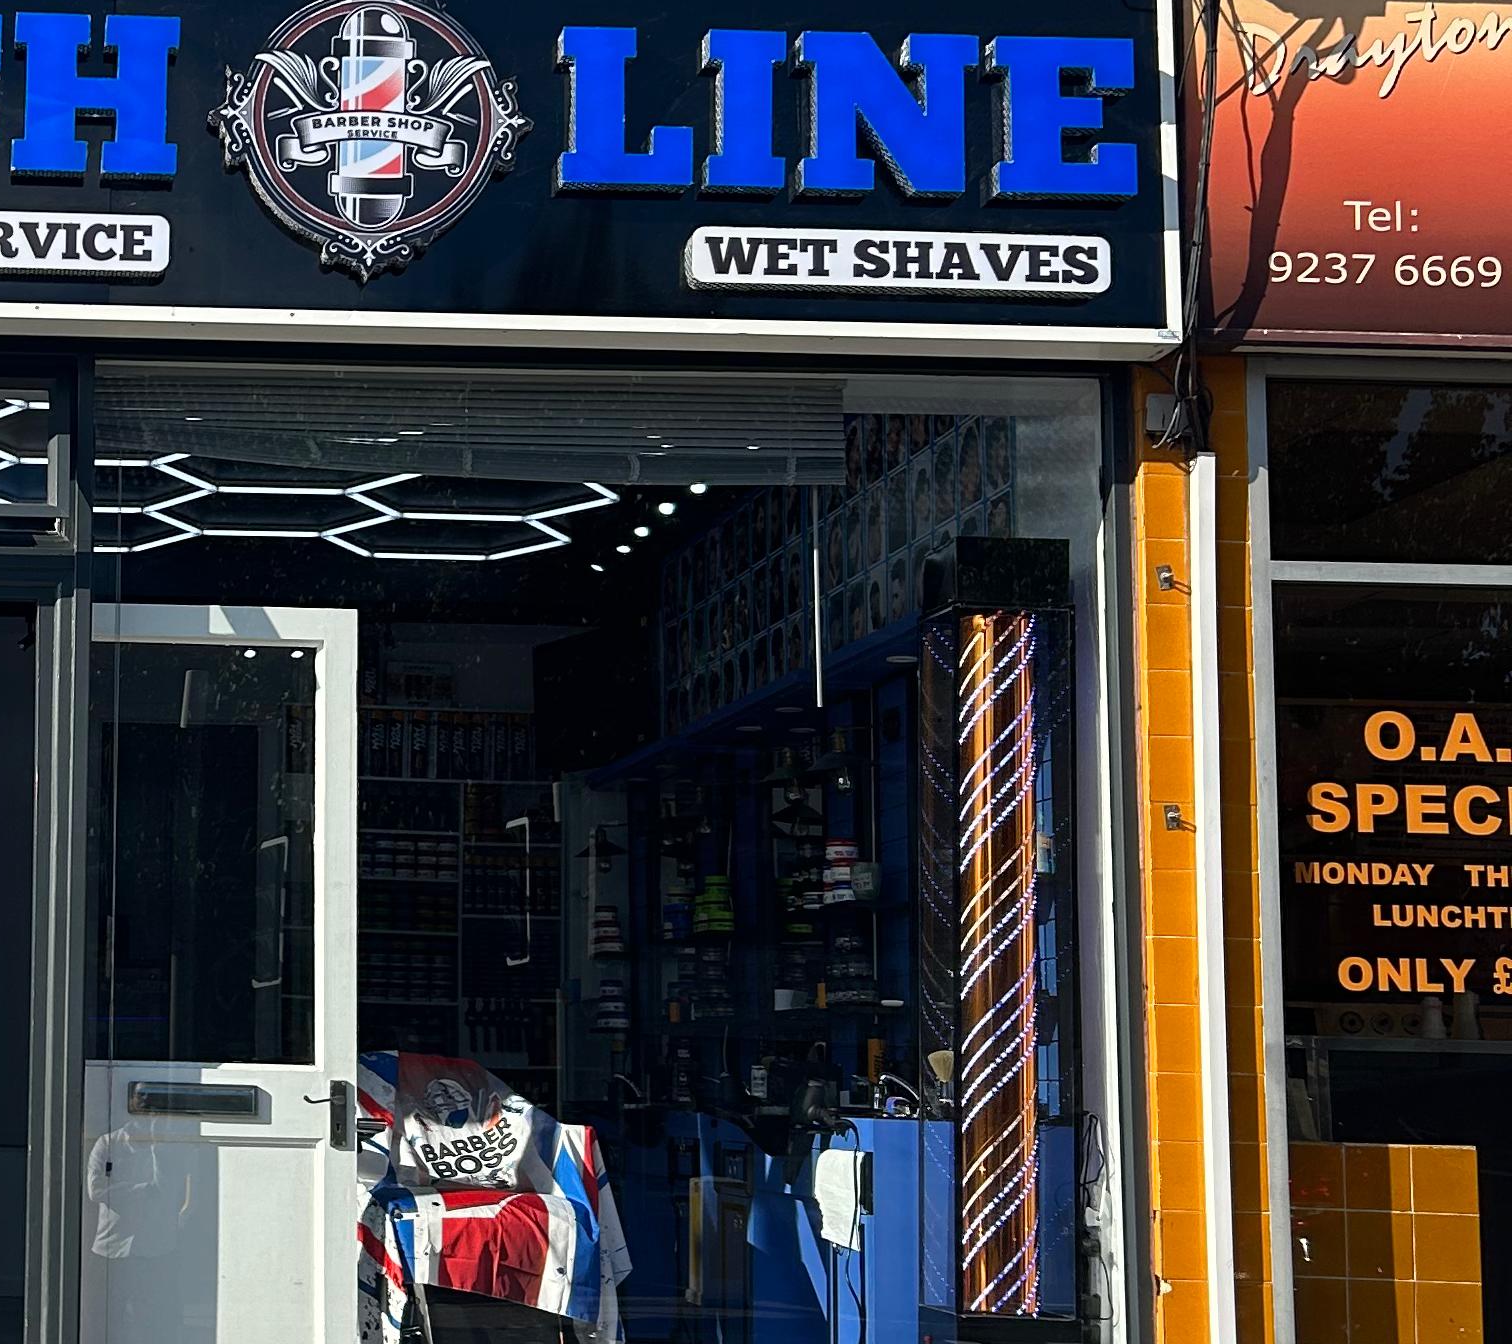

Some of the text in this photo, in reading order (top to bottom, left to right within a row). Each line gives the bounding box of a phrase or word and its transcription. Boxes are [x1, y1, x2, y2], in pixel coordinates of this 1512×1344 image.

[312, 116, 434, 132] BARBER SHOP
[558, 26, 1138, 195] LINE
[347, 129, 398, 139] SERVICE
[1343, 200, 1420, 233] Tel:
[704, 236, 1099, 285] WET SHAVES
[1269, 251, 1503, 288] 9237 6669
[1306, 782, 1512, 836] SPEC
[1295, 862, 1512, 888] MONDAY TH
[1373, 904, 1512, 929] LUNCHT
[1338, 957, 1476, 993] ONLY
[420, 1116, 512, 1163] BARBER
[431, 1132, 518, 1179] BOSS
